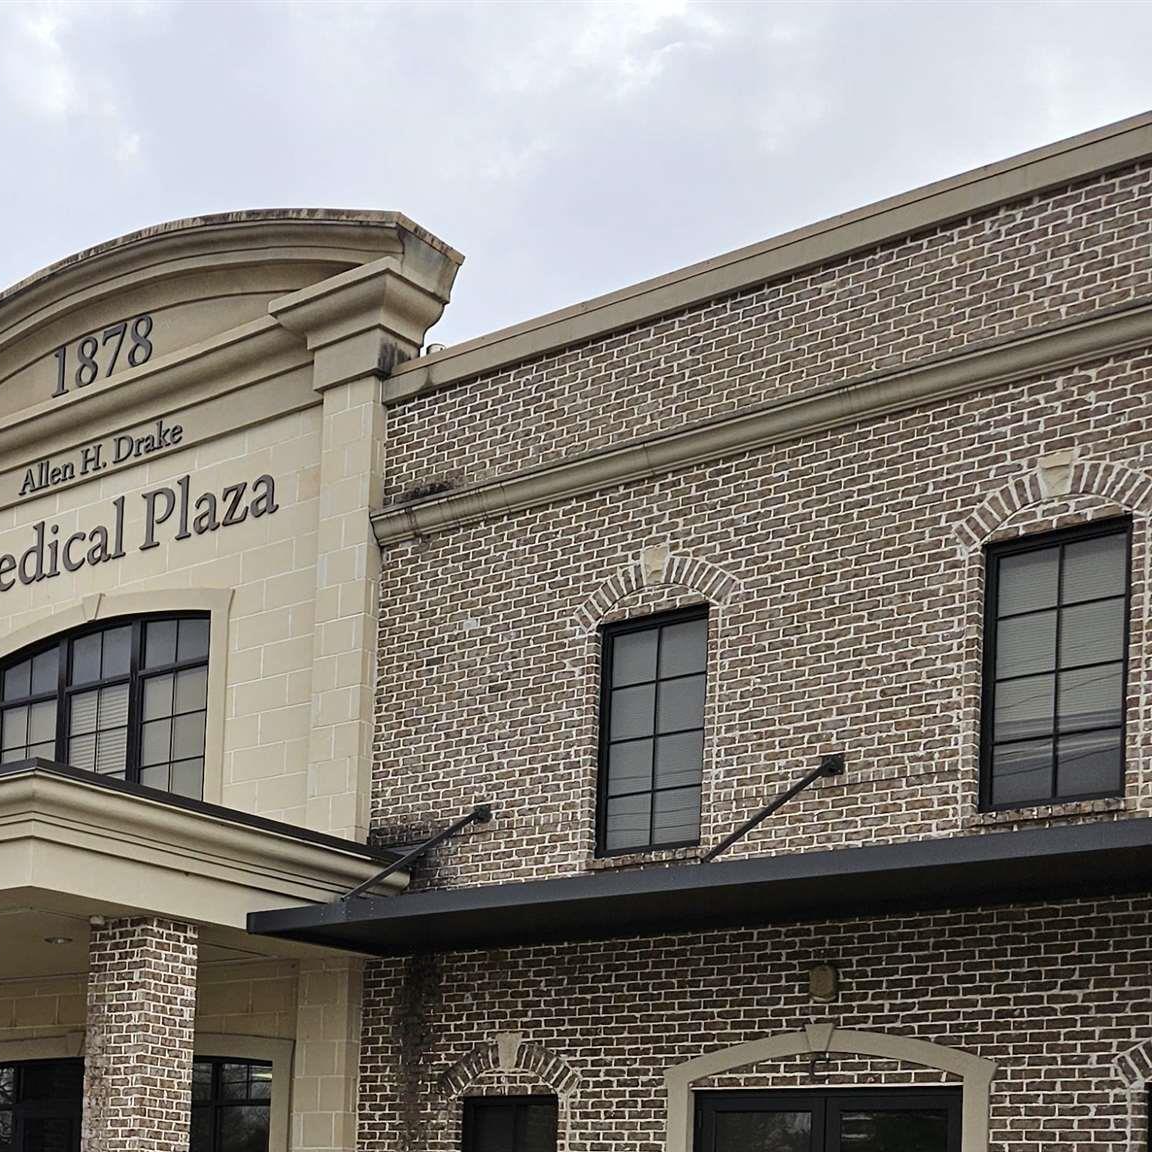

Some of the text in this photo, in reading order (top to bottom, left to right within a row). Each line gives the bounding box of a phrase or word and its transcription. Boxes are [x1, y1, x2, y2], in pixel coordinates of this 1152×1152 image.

[51, 312, 154, 398] 1878
[18, 420, 184, 496] Allen H. Drake
[138, 473, 279, 551] Plaza
